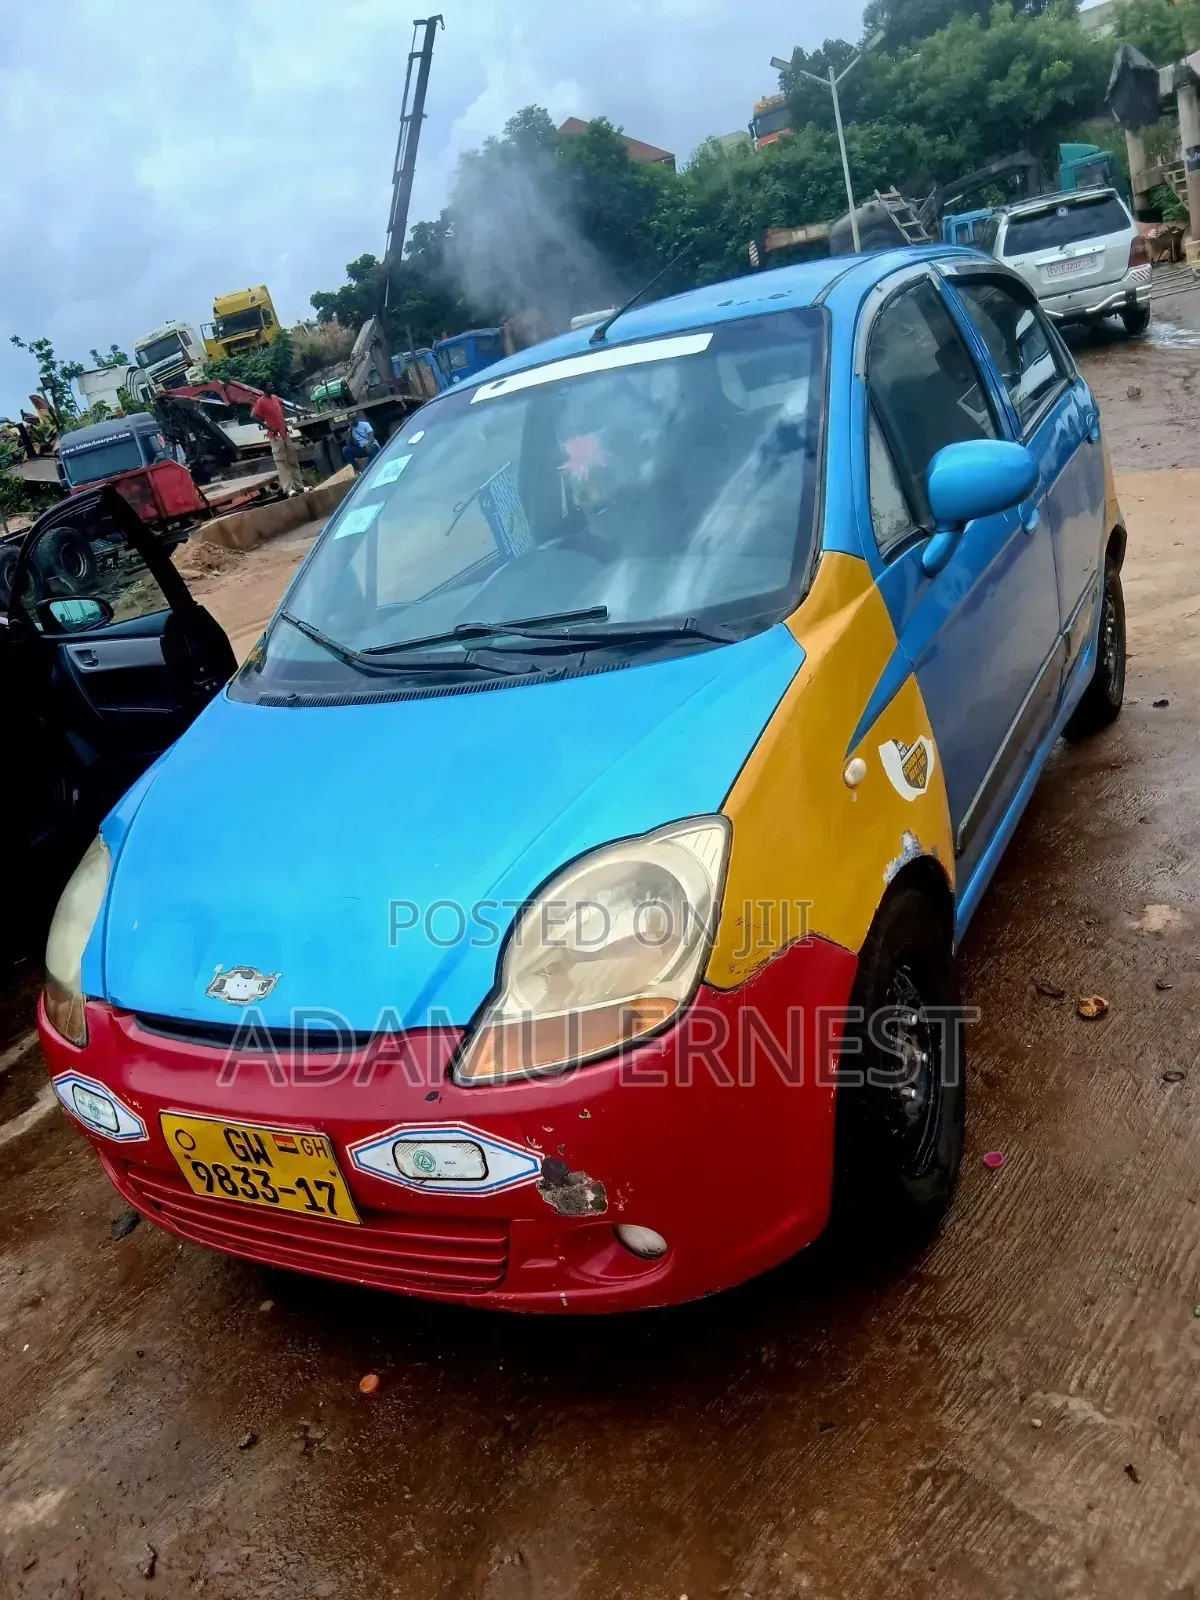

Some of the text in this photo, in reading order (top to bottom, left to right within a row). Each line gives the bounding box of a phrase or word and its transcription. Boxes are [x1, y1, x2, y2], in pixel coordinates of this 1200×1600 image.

[223, 1126, 274, 1168] GW
[300, 1137, 329, 1159] GH
[190, 1159, 339, 1216] 9833-17
